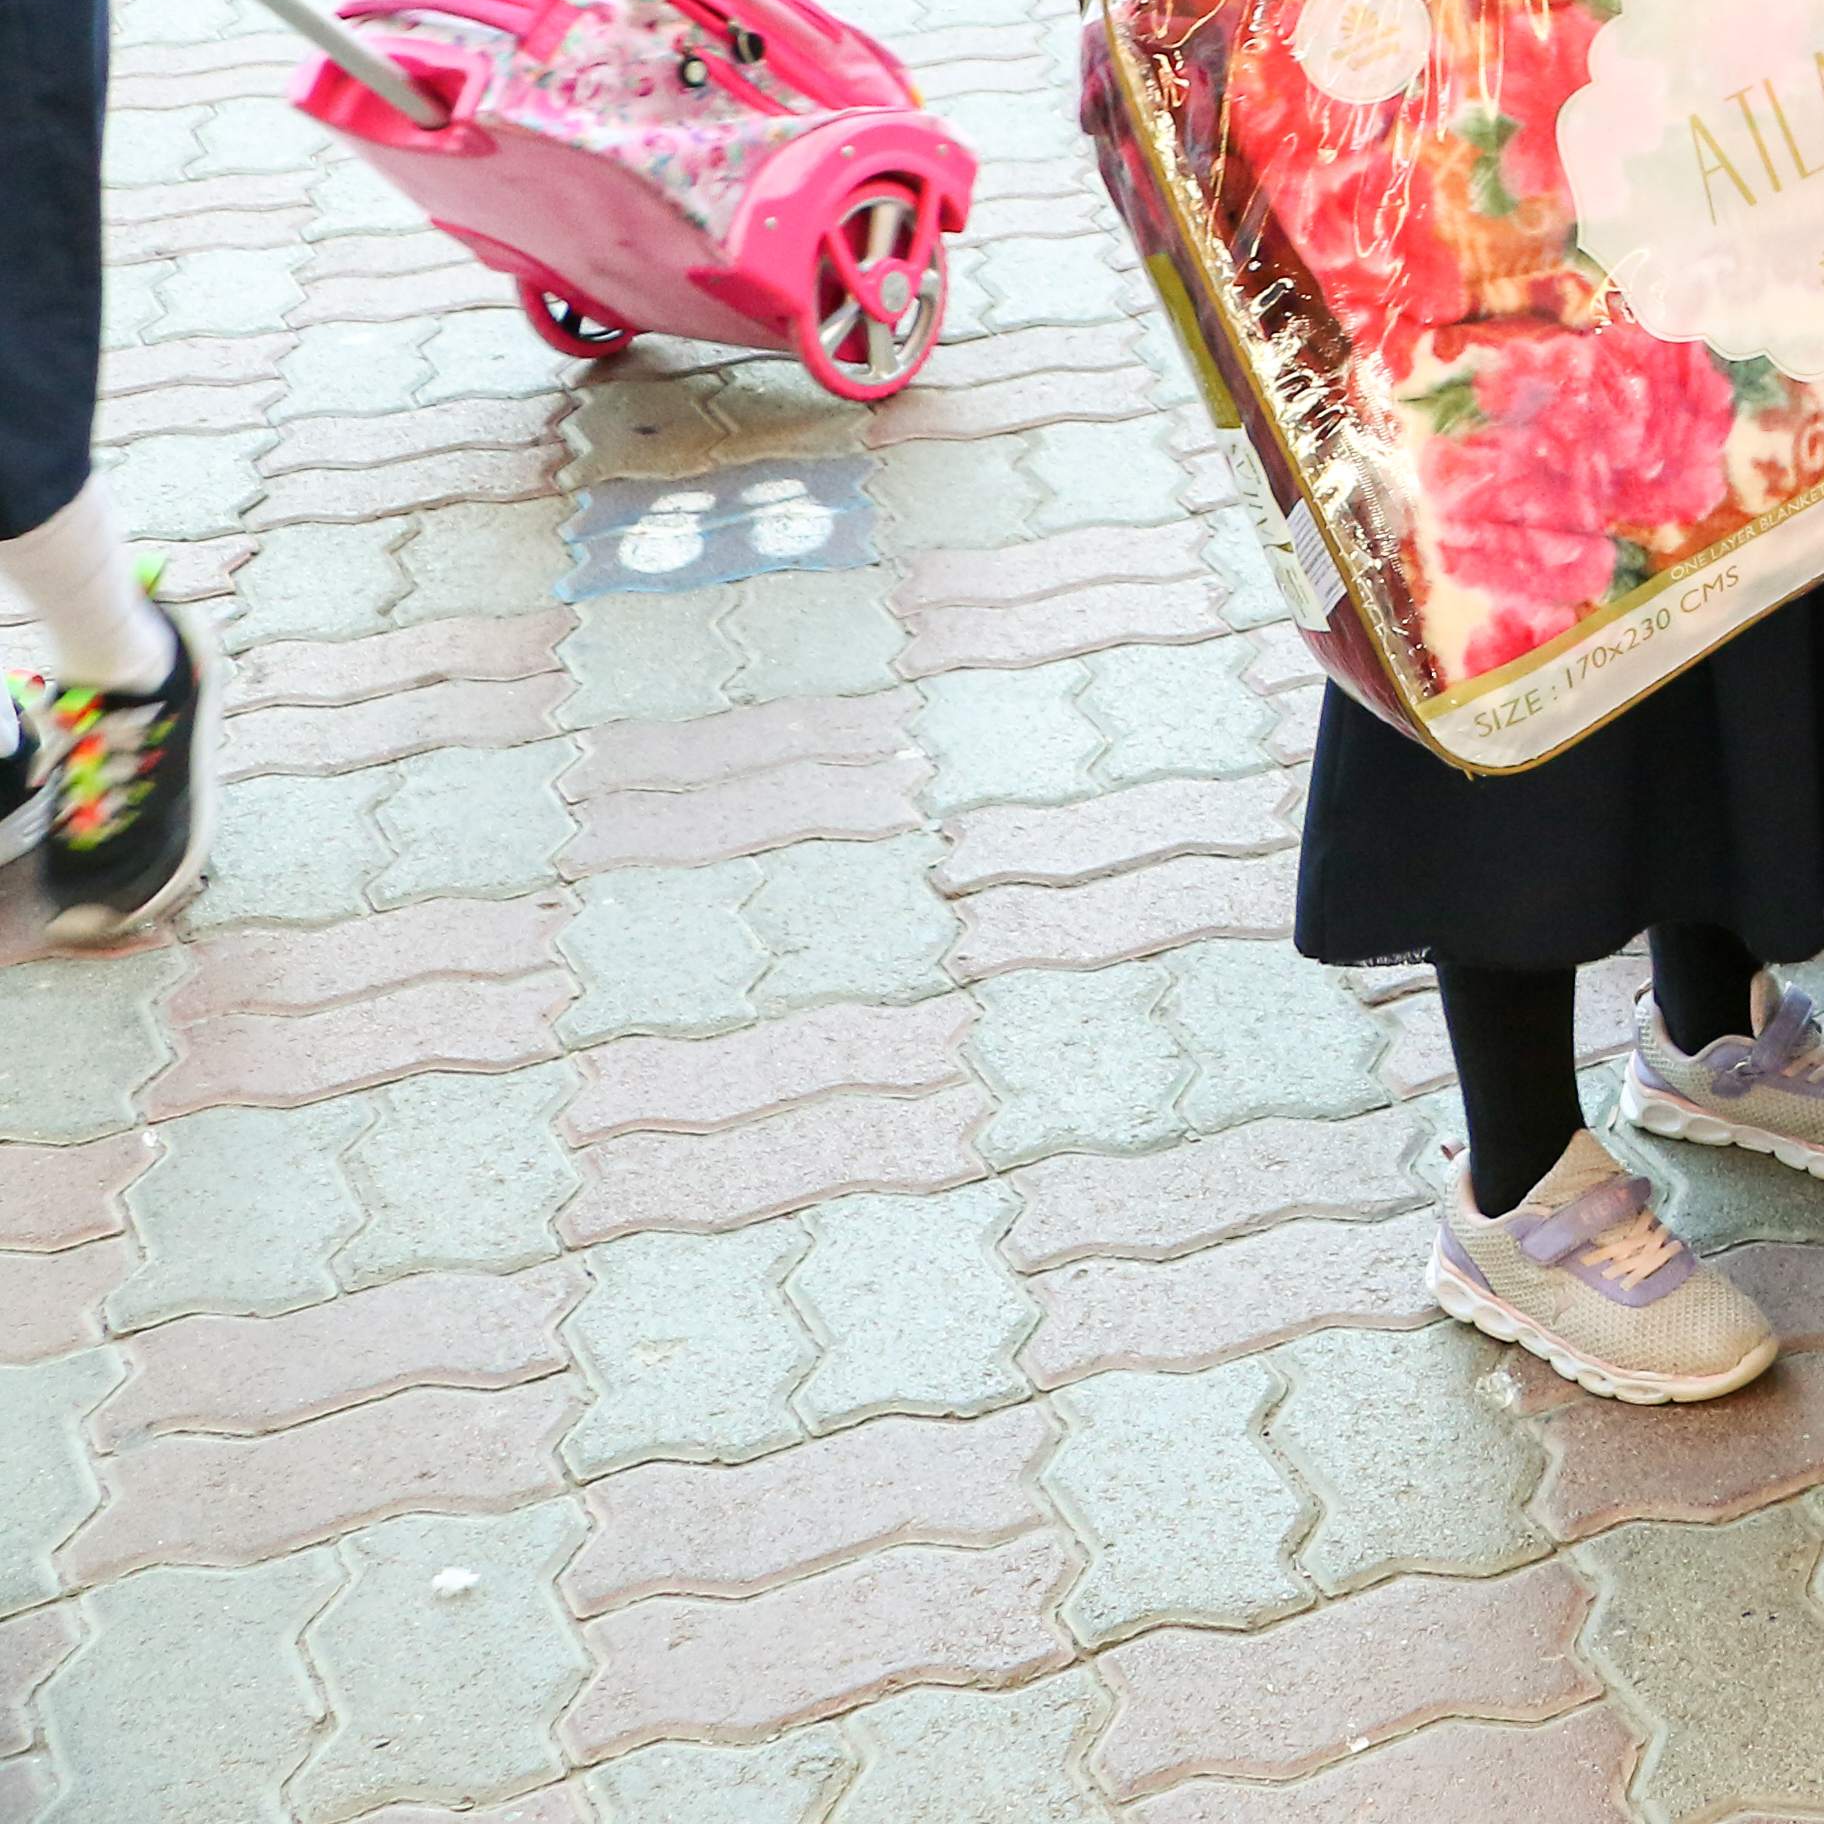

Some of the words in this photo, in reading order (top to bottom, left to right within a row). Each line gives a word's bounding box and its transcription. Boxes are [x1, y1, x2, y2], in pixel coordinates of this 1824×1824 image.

[1670, 554, 1707, 581] ONE
[1709, 526, 1756, 561] LAYER
[1473, 688, 1544, 739] SIZE
[1564, 607, 1672, 690] 170x230
[1679, 564, 1740, 613] CMS
